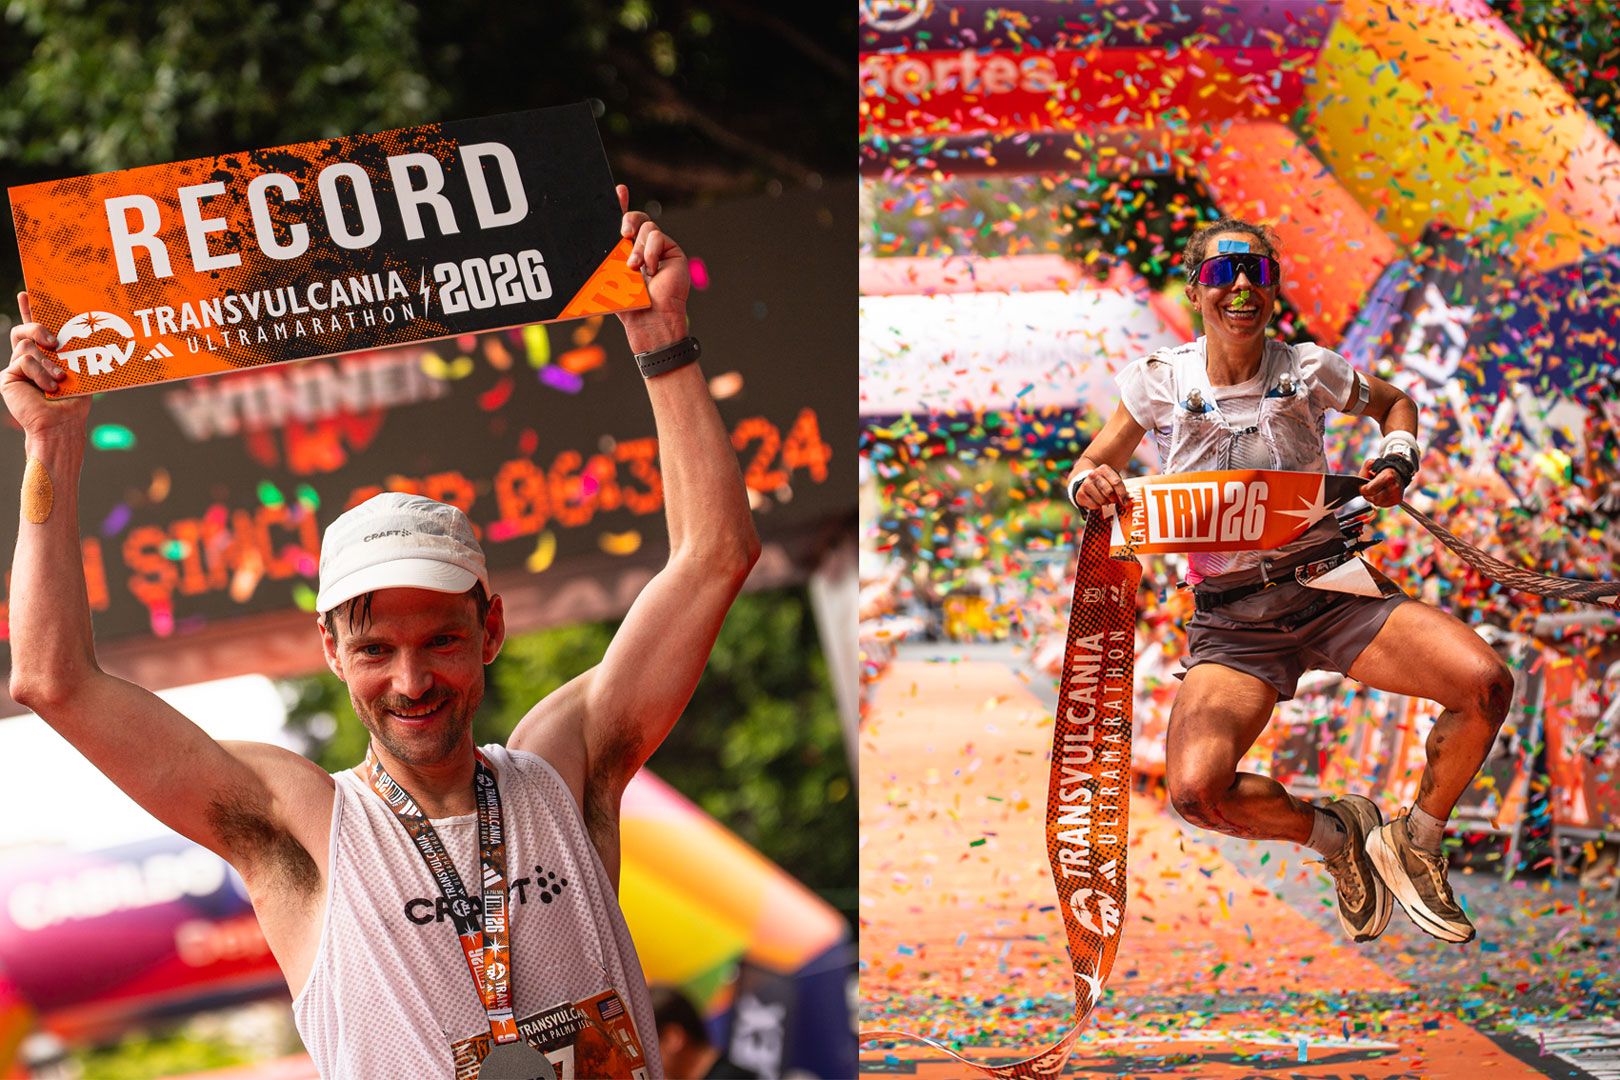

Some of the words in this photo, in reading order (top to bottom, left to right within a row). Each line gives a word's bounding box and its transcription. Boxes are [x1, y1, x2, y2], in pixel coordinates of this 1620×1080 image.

[104, 142, 530, 285] RECORD
[134, 270, 410, 338] TRANSVULCANIA
[433, 248, 553, 316] 2026
[187, 304, 416, 355] ULTRAMARATHON
[57, 340, 137, 377] TRV
[363, 529, 401, 543] CRAFT
[1132, 528, 1145, 545] LA
[1150, 484, 1217, 541] TRV
[1220, 481, 1269, 542] 26
[1057, 632, 1105, 879] TRANSVULCANIA
[1098, 630, 1126, 845] ULTRAMARATHON
[484, 787, 502, 845] TRANSVULCANIA
[416, 832, 458, 899] TRANSVULCANIA
[427, 830, 463, 887] ULTRAMARATHON
[404, 877, 531, 925] CRAT
[485, 917, 505, 933] 26
[537, 1033, 548, 1045] LA
[550, 1023, 577, 1038] PALMA
